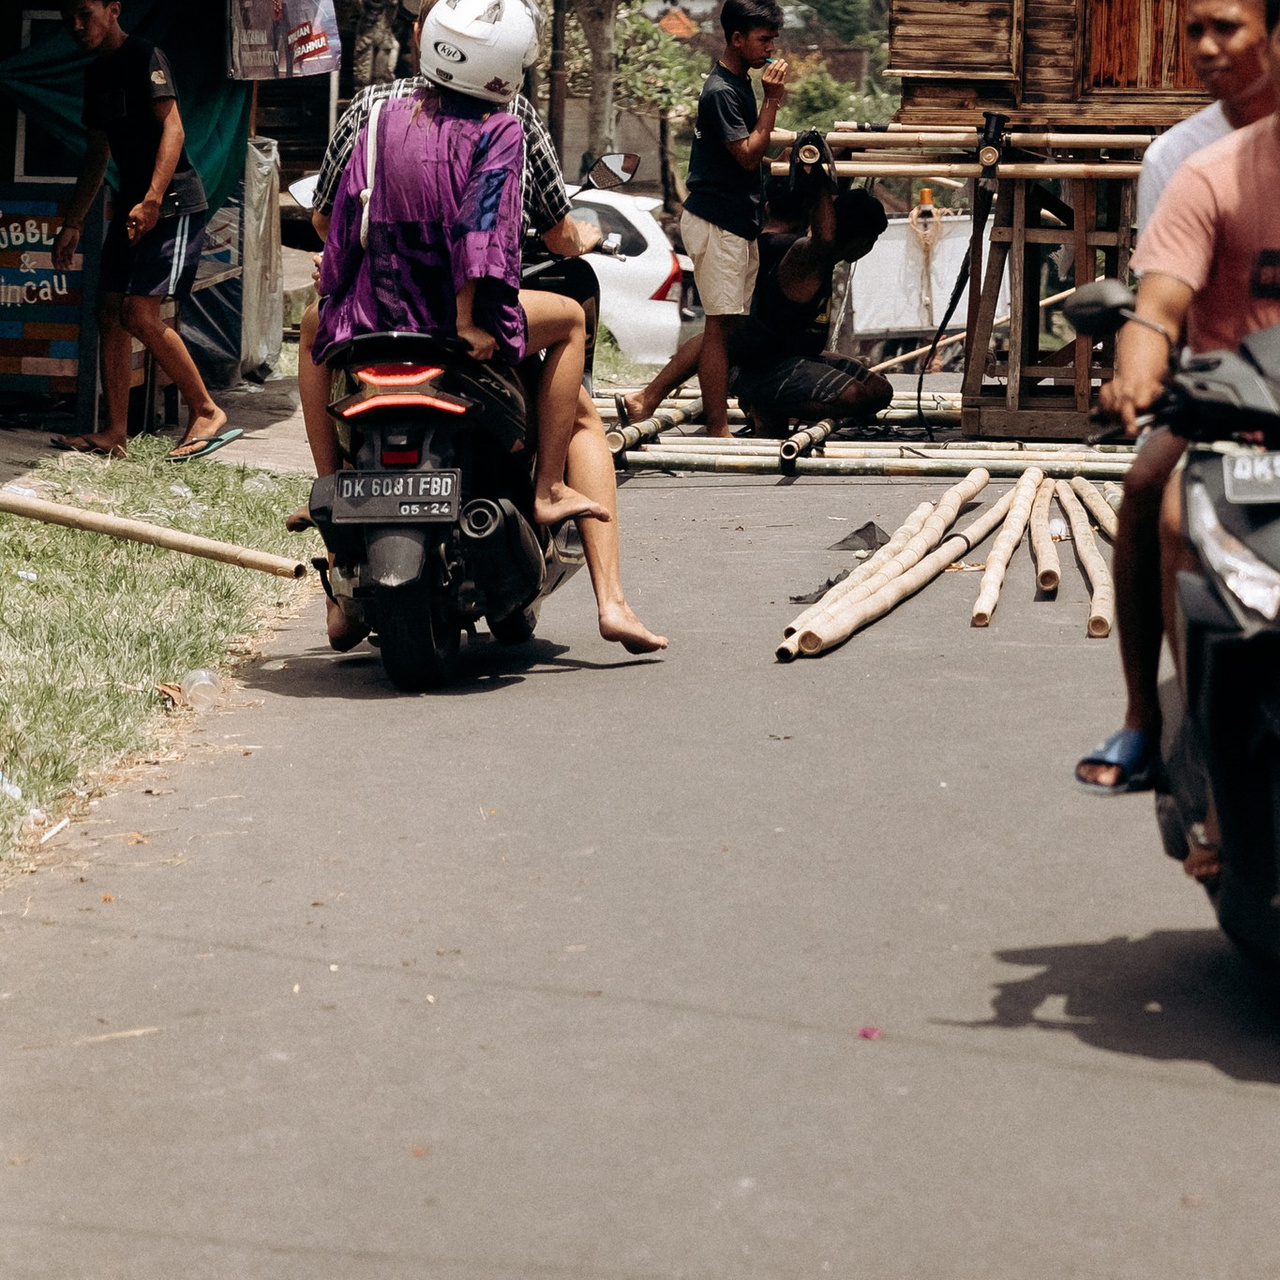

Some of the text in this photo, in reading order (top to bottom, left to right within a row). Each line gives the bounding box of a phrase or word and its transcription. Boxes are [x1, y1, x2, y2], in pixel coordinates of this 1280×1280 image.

[20, 253, 37, 274] &
[342, 479, 365, 498] DK
[418, 477, 452, 496] FBD
